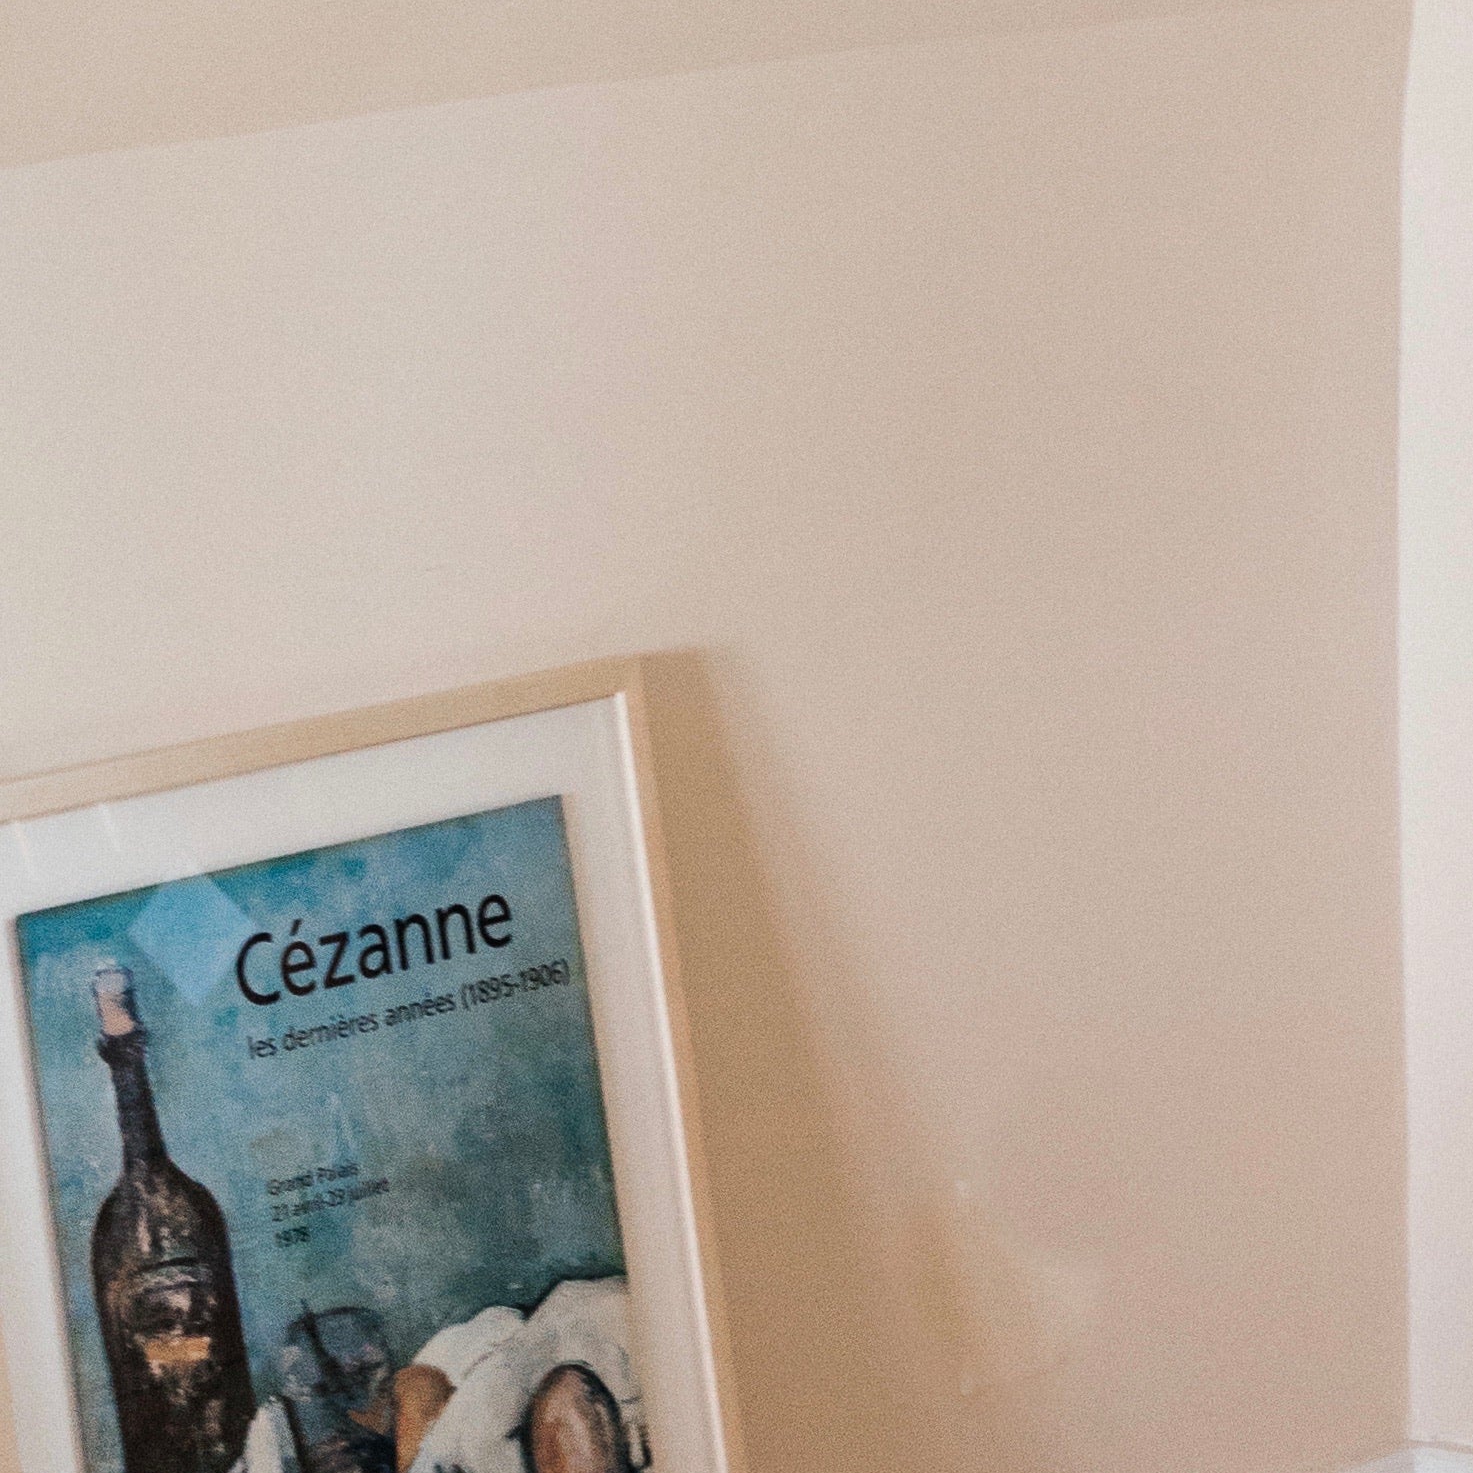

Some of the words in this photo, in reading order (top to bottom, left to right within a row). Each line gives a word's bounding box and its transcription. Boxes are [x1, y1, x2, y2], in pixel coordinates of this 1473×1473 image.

[236, 894, 513, 1005] Cézanne
[248, 1036, 278, 1059] les
[282, 1014, 380, 1052] dernières
[385, 988, 455, 1027] années
[460, 959, 571, 1011] (1895-1906)
